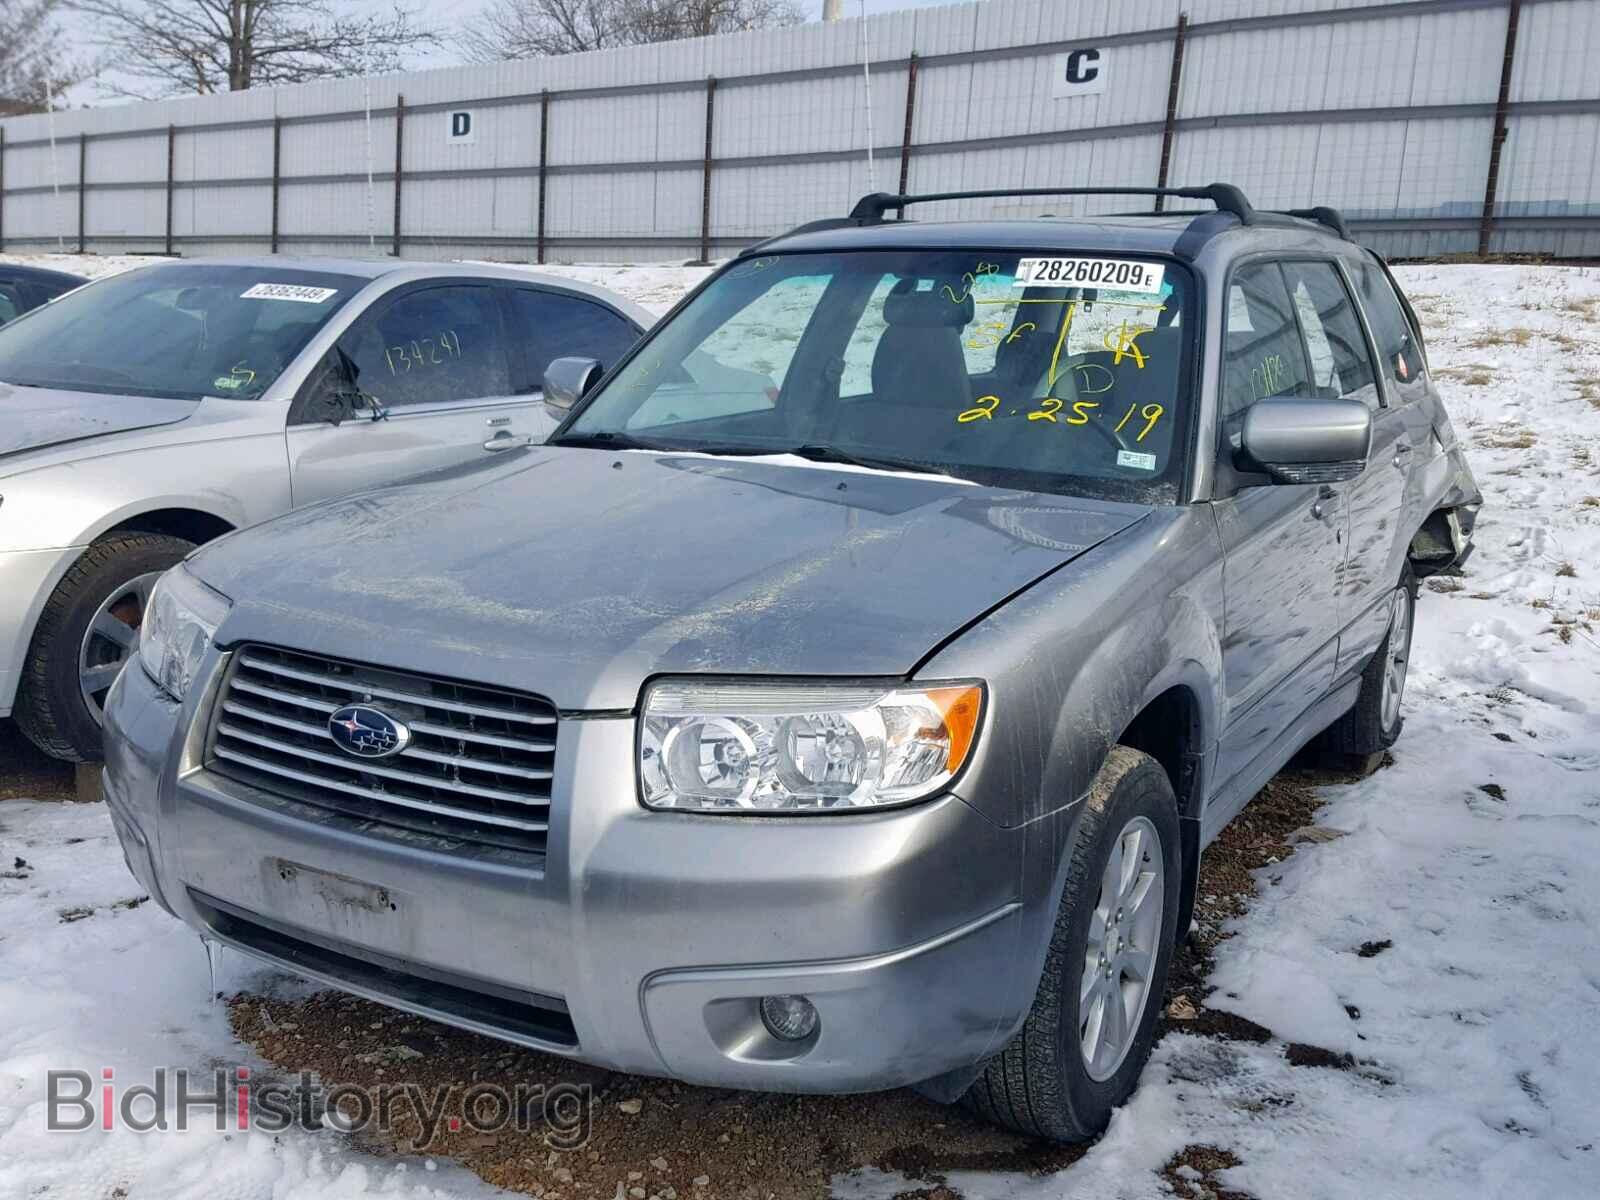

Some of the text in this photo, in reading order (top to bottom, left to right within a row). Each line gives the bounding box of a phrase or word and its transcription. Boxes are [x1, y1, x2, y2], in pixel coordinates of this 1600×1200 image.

[1066, 48, 1100, 84] C
[452, 112, 471, 136] D
[1034, 260, 1144, 286] 28260209
